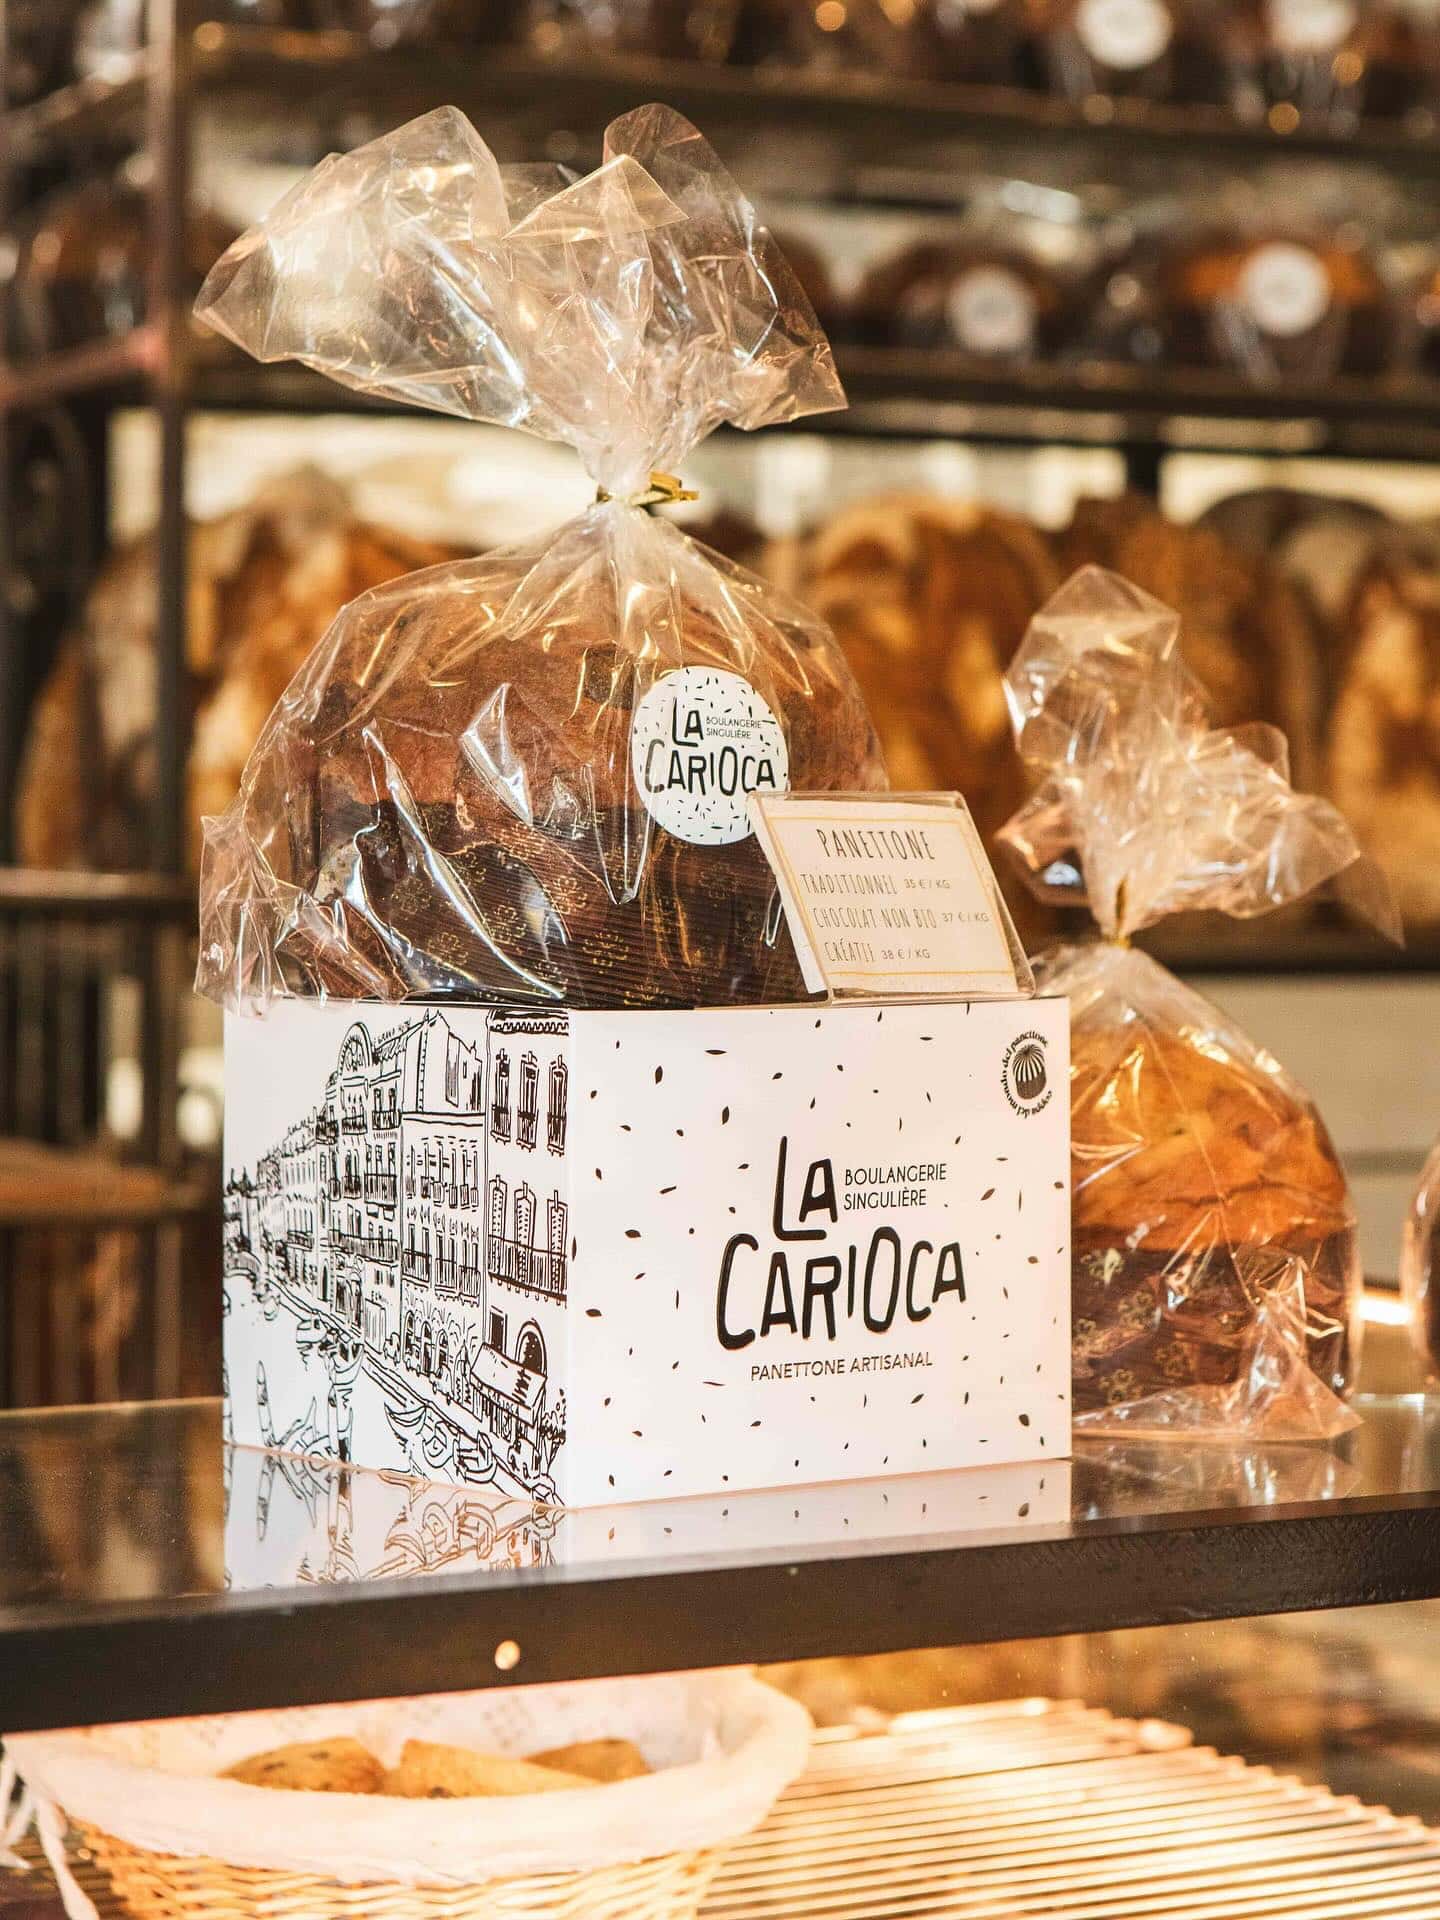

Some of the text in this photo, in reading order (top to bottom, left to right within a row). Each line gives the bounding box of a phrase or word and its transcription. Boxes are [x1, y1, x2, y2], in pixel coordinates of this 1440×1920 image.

[671, 697, 704, 747] LA
[706, 717, 761, 729] BOULANGERIE
[645, 738, 776, 796] CARIOCA
[816, 829, 936, 860] PANETTONE
[800, 873, 898, 895] TRADITIONNEL
[935, 879, 951, 889] KG
[813, 907, 877, 929] CHOCOLAT
[881, 908, 910, 929] NON
[913, 908, 937, 929] BIO
[974, 912, 990, 923] KG
[881, 949, 895, 960] 38
[915, 949, 931, 959] KG
[844, 1163, 947, 1186] BOULANGERIE
[772, 1136, 838, 1241] LA
[843, 1186, 927, 1210] SINGULIÈRE
[716, 1226, 967, 1351] CARIOCA
[751, 1351, 933, 1382] PANETTONE ARTISANAL
